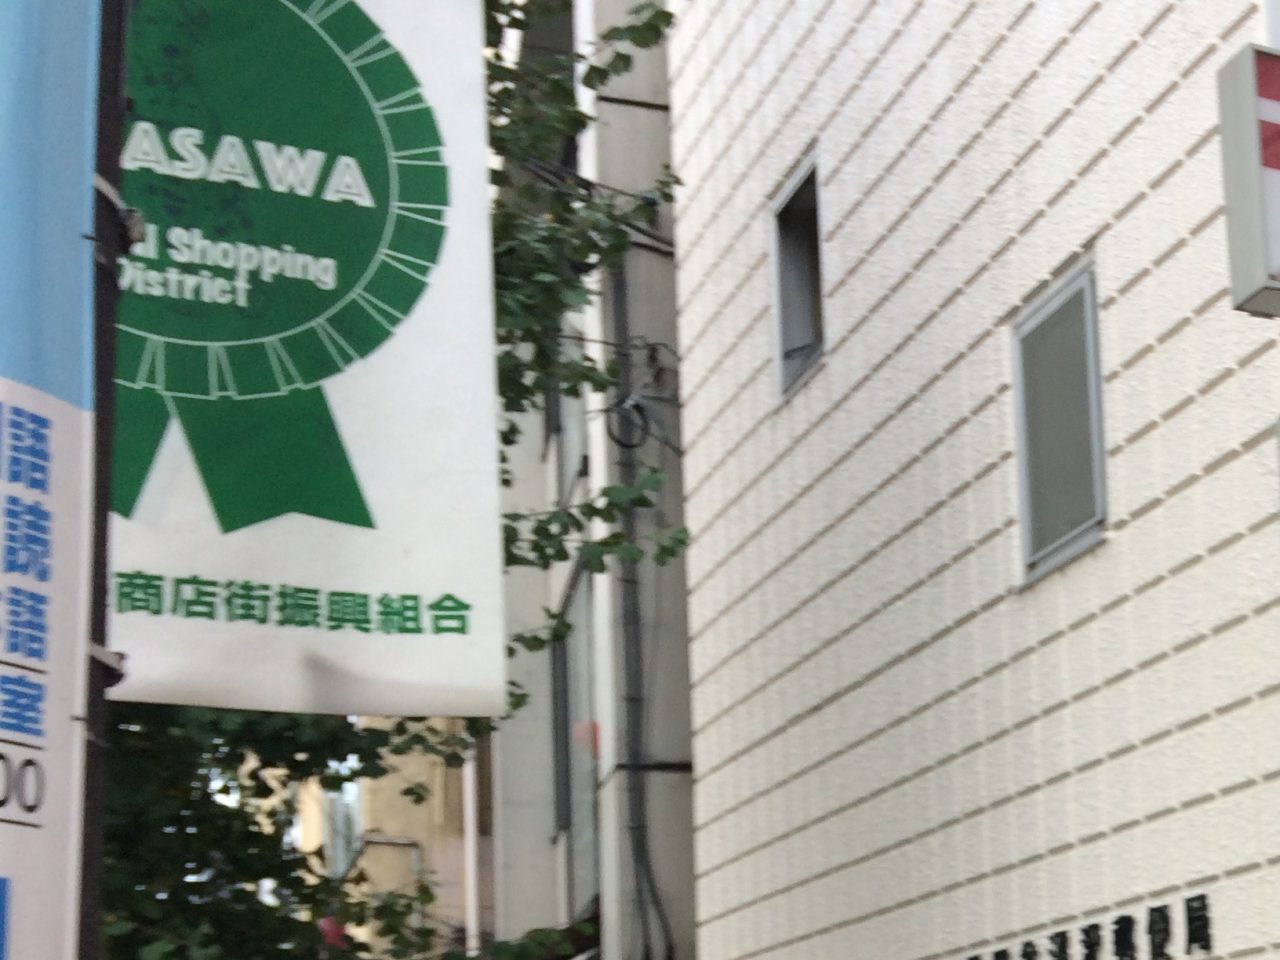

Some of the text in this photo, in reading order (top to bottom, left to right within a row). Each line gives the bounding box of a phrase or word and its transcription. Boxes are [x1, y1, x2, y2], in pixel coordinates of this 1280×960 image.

[120, 119, 377, 208] ASAWA
[165, 225, 339, 291] Shopping
[114, 570, 472, 635] 商店街振興組合
